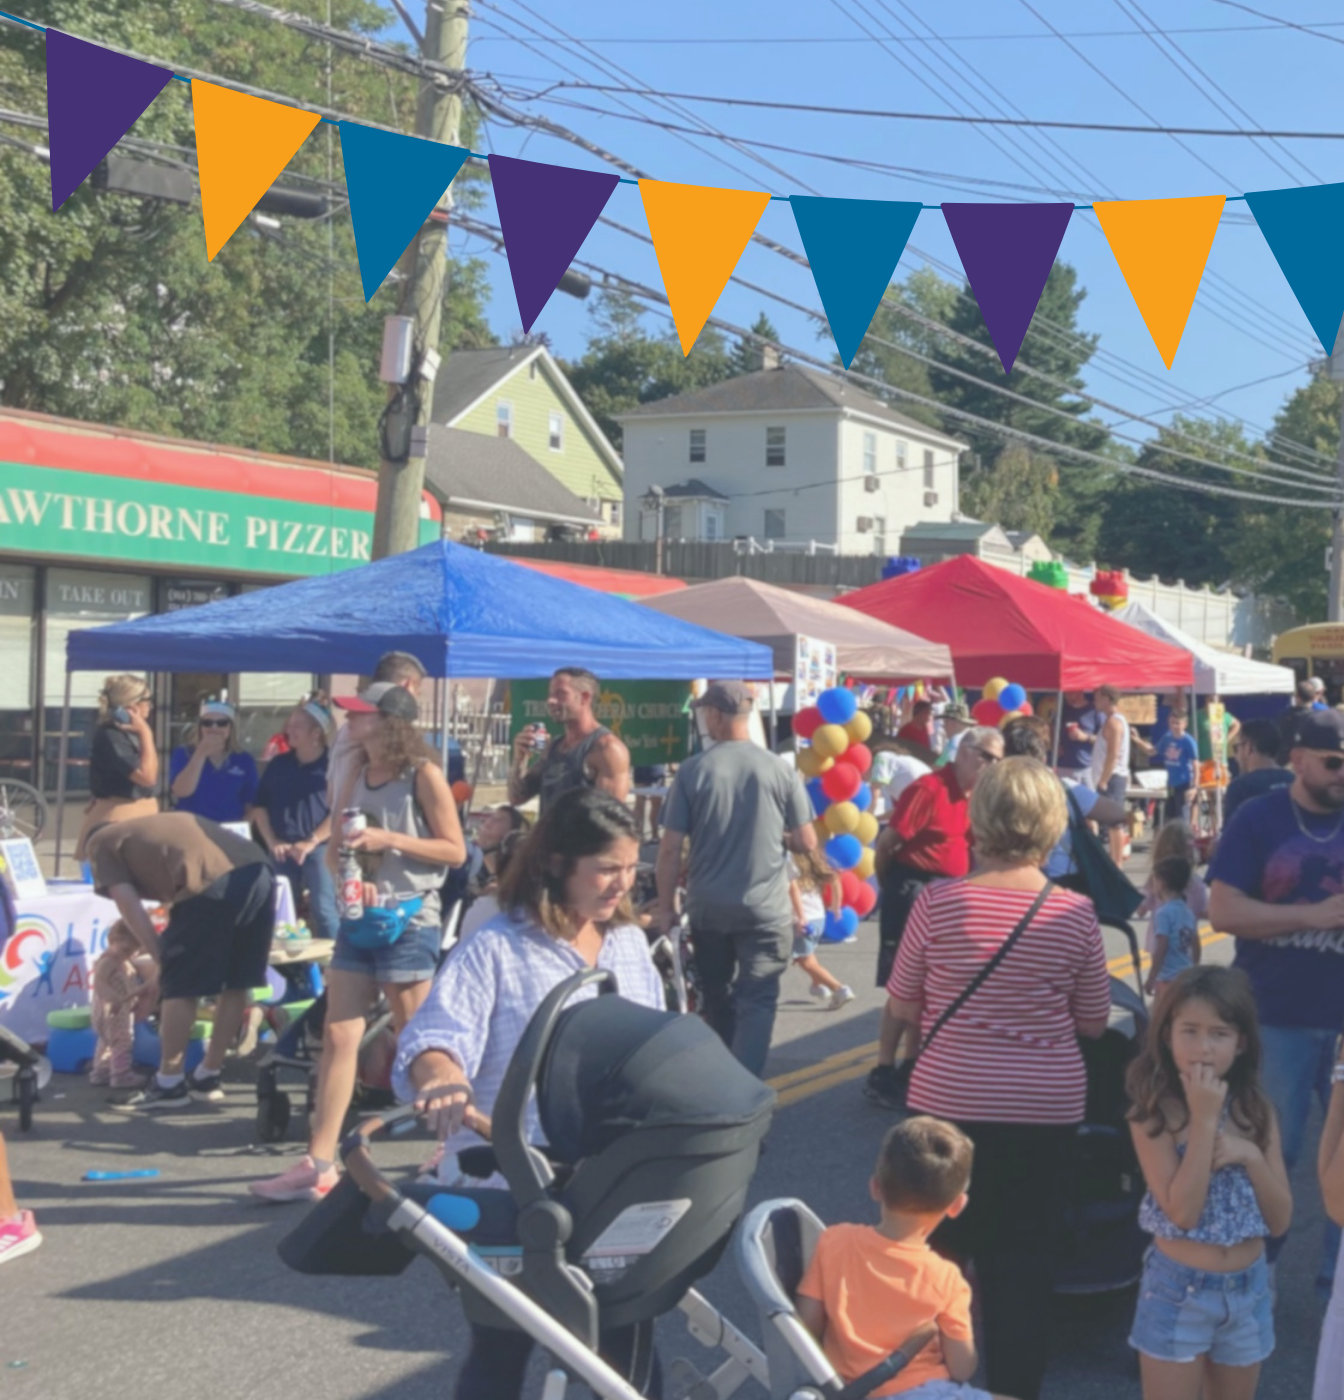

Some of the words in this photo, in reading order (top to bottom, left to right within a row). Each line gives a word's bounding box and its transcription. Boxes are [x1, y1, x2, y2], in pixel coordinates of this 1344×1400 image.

[245, 515, 371, 562] PIZZER
[60, 584, 105, 604] TAKE
[110, 589, 144, 606] OUT
